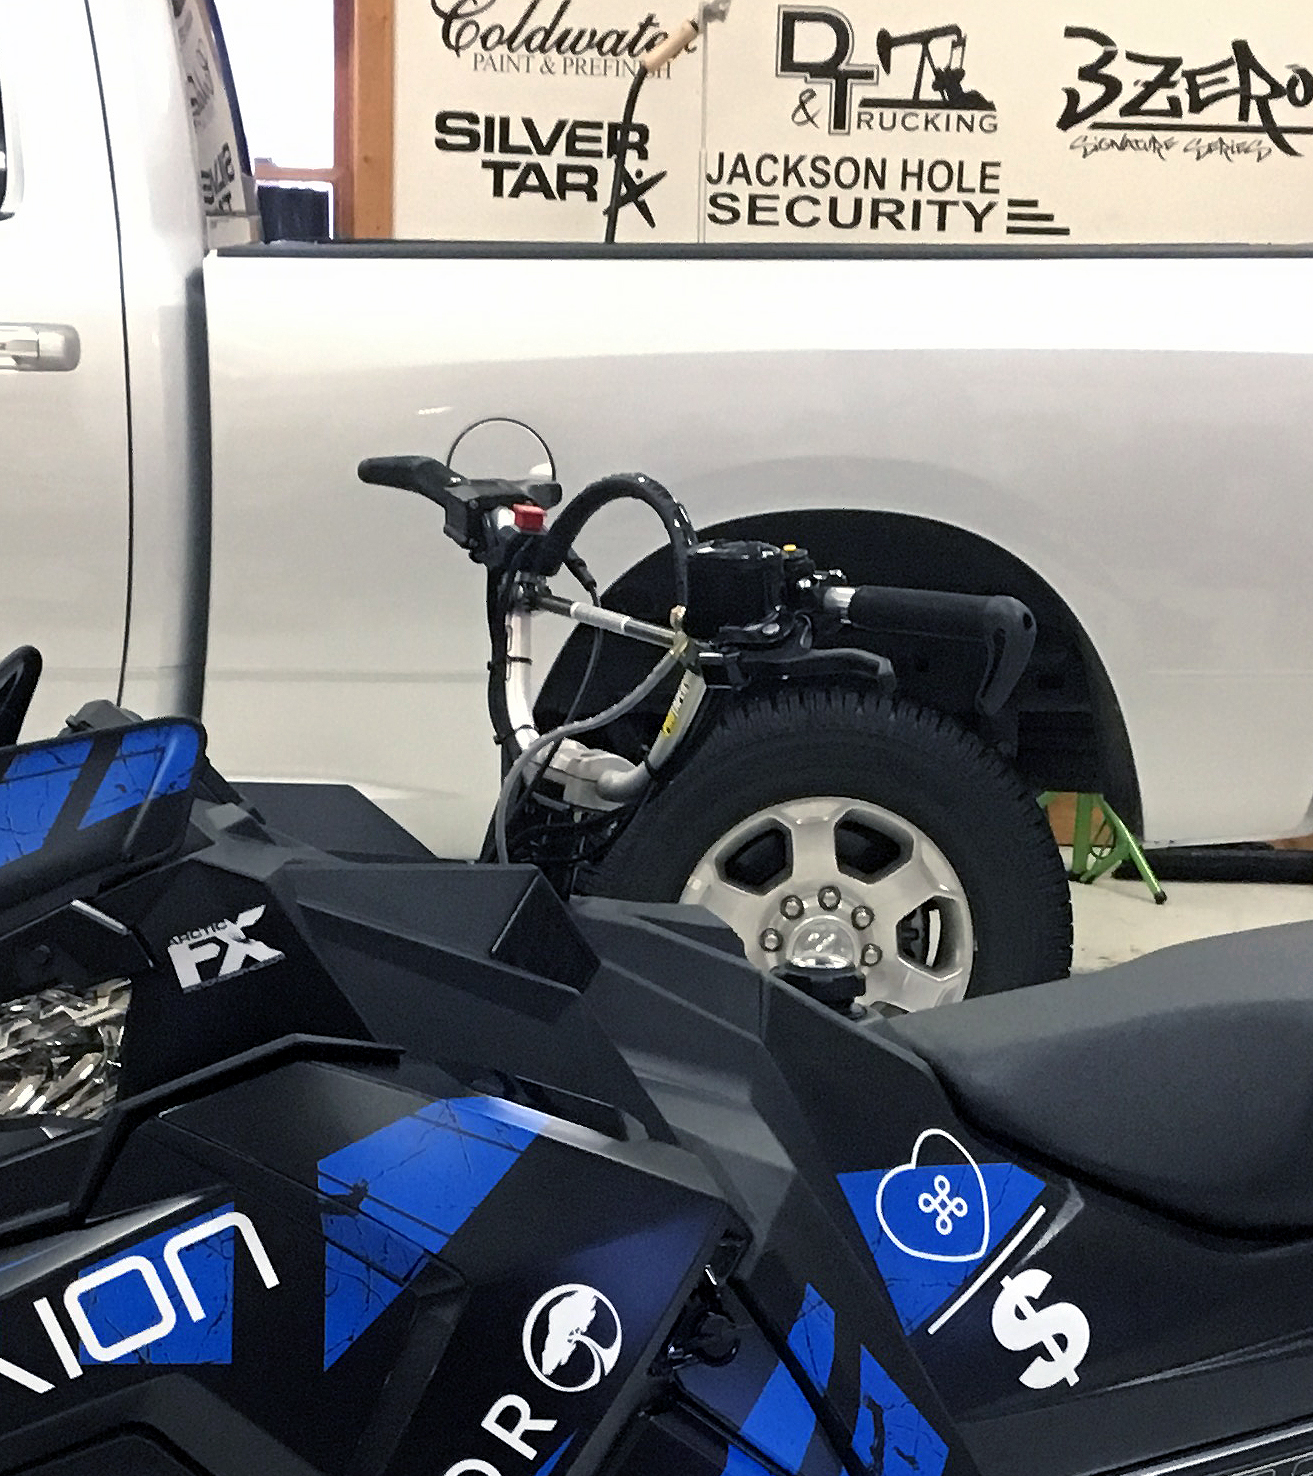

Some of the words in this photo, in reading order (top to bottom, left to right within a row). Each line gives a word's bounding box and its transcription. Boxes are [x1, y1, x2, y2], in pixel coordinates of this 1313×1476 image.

[432, 0, 697, 58] Coldwate
[473, 52, 533, 73] PAINT
[539, 57, 556, 75] &
[562, 57, 672, 80] PREFINH
[435, 110, 650, 160] SILVER
[1069, 133, 1178, 161] SIGNATURE
[1183, 136, 1272, 162] SERIES
[706, 152, 887, 191] JACKSON
[901, 159, 1002, 195] HOLE
[707, 192, 998, 233] SECURITY
[168, 904, 286, 990] FX
